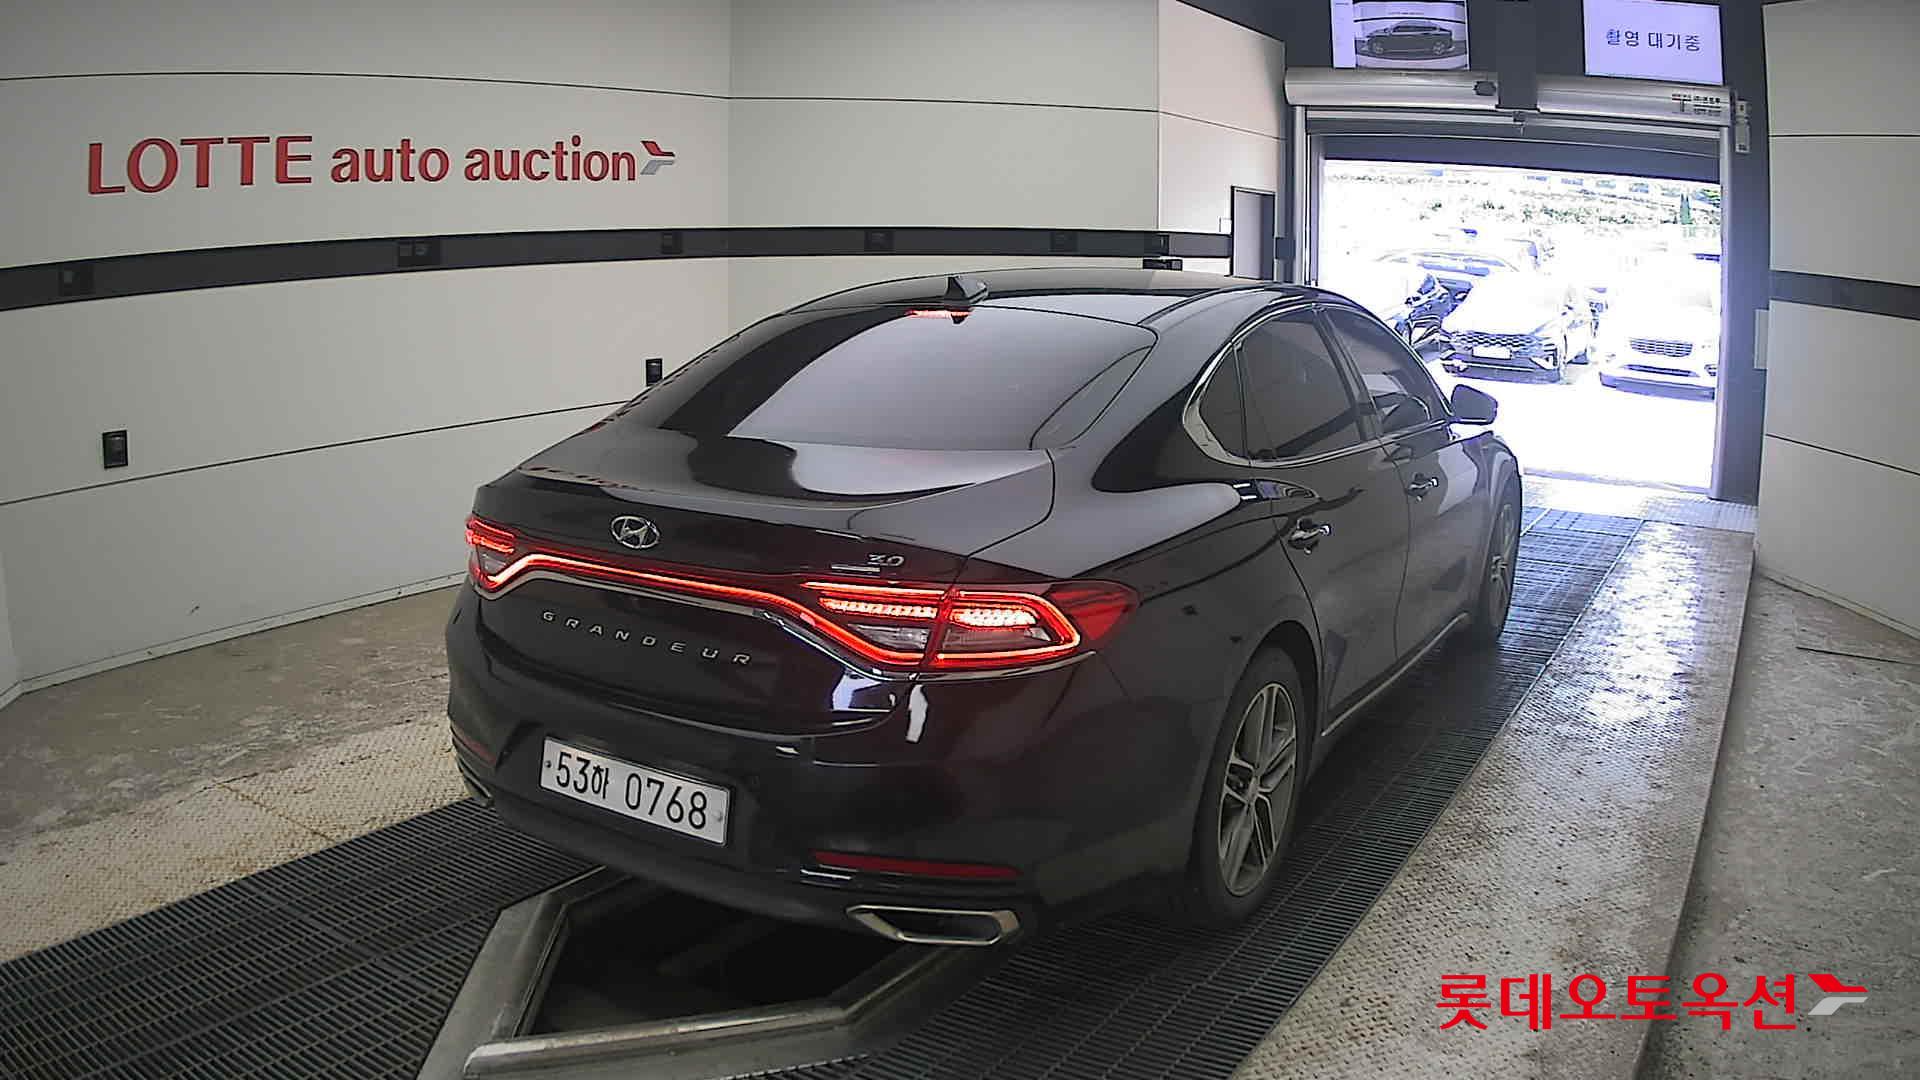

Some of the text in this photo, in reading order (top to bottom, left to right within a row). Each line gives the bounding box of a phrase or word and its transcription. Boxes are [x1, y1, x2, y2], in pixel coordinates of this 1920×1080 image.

[1648, 32, 1701, 52] 대기중
[88, 135, 637, 195] LOTTE auto auction
[543, 610, 751, 665] GRANDEUR
[556, 751, 708, 830] 53하 0768
